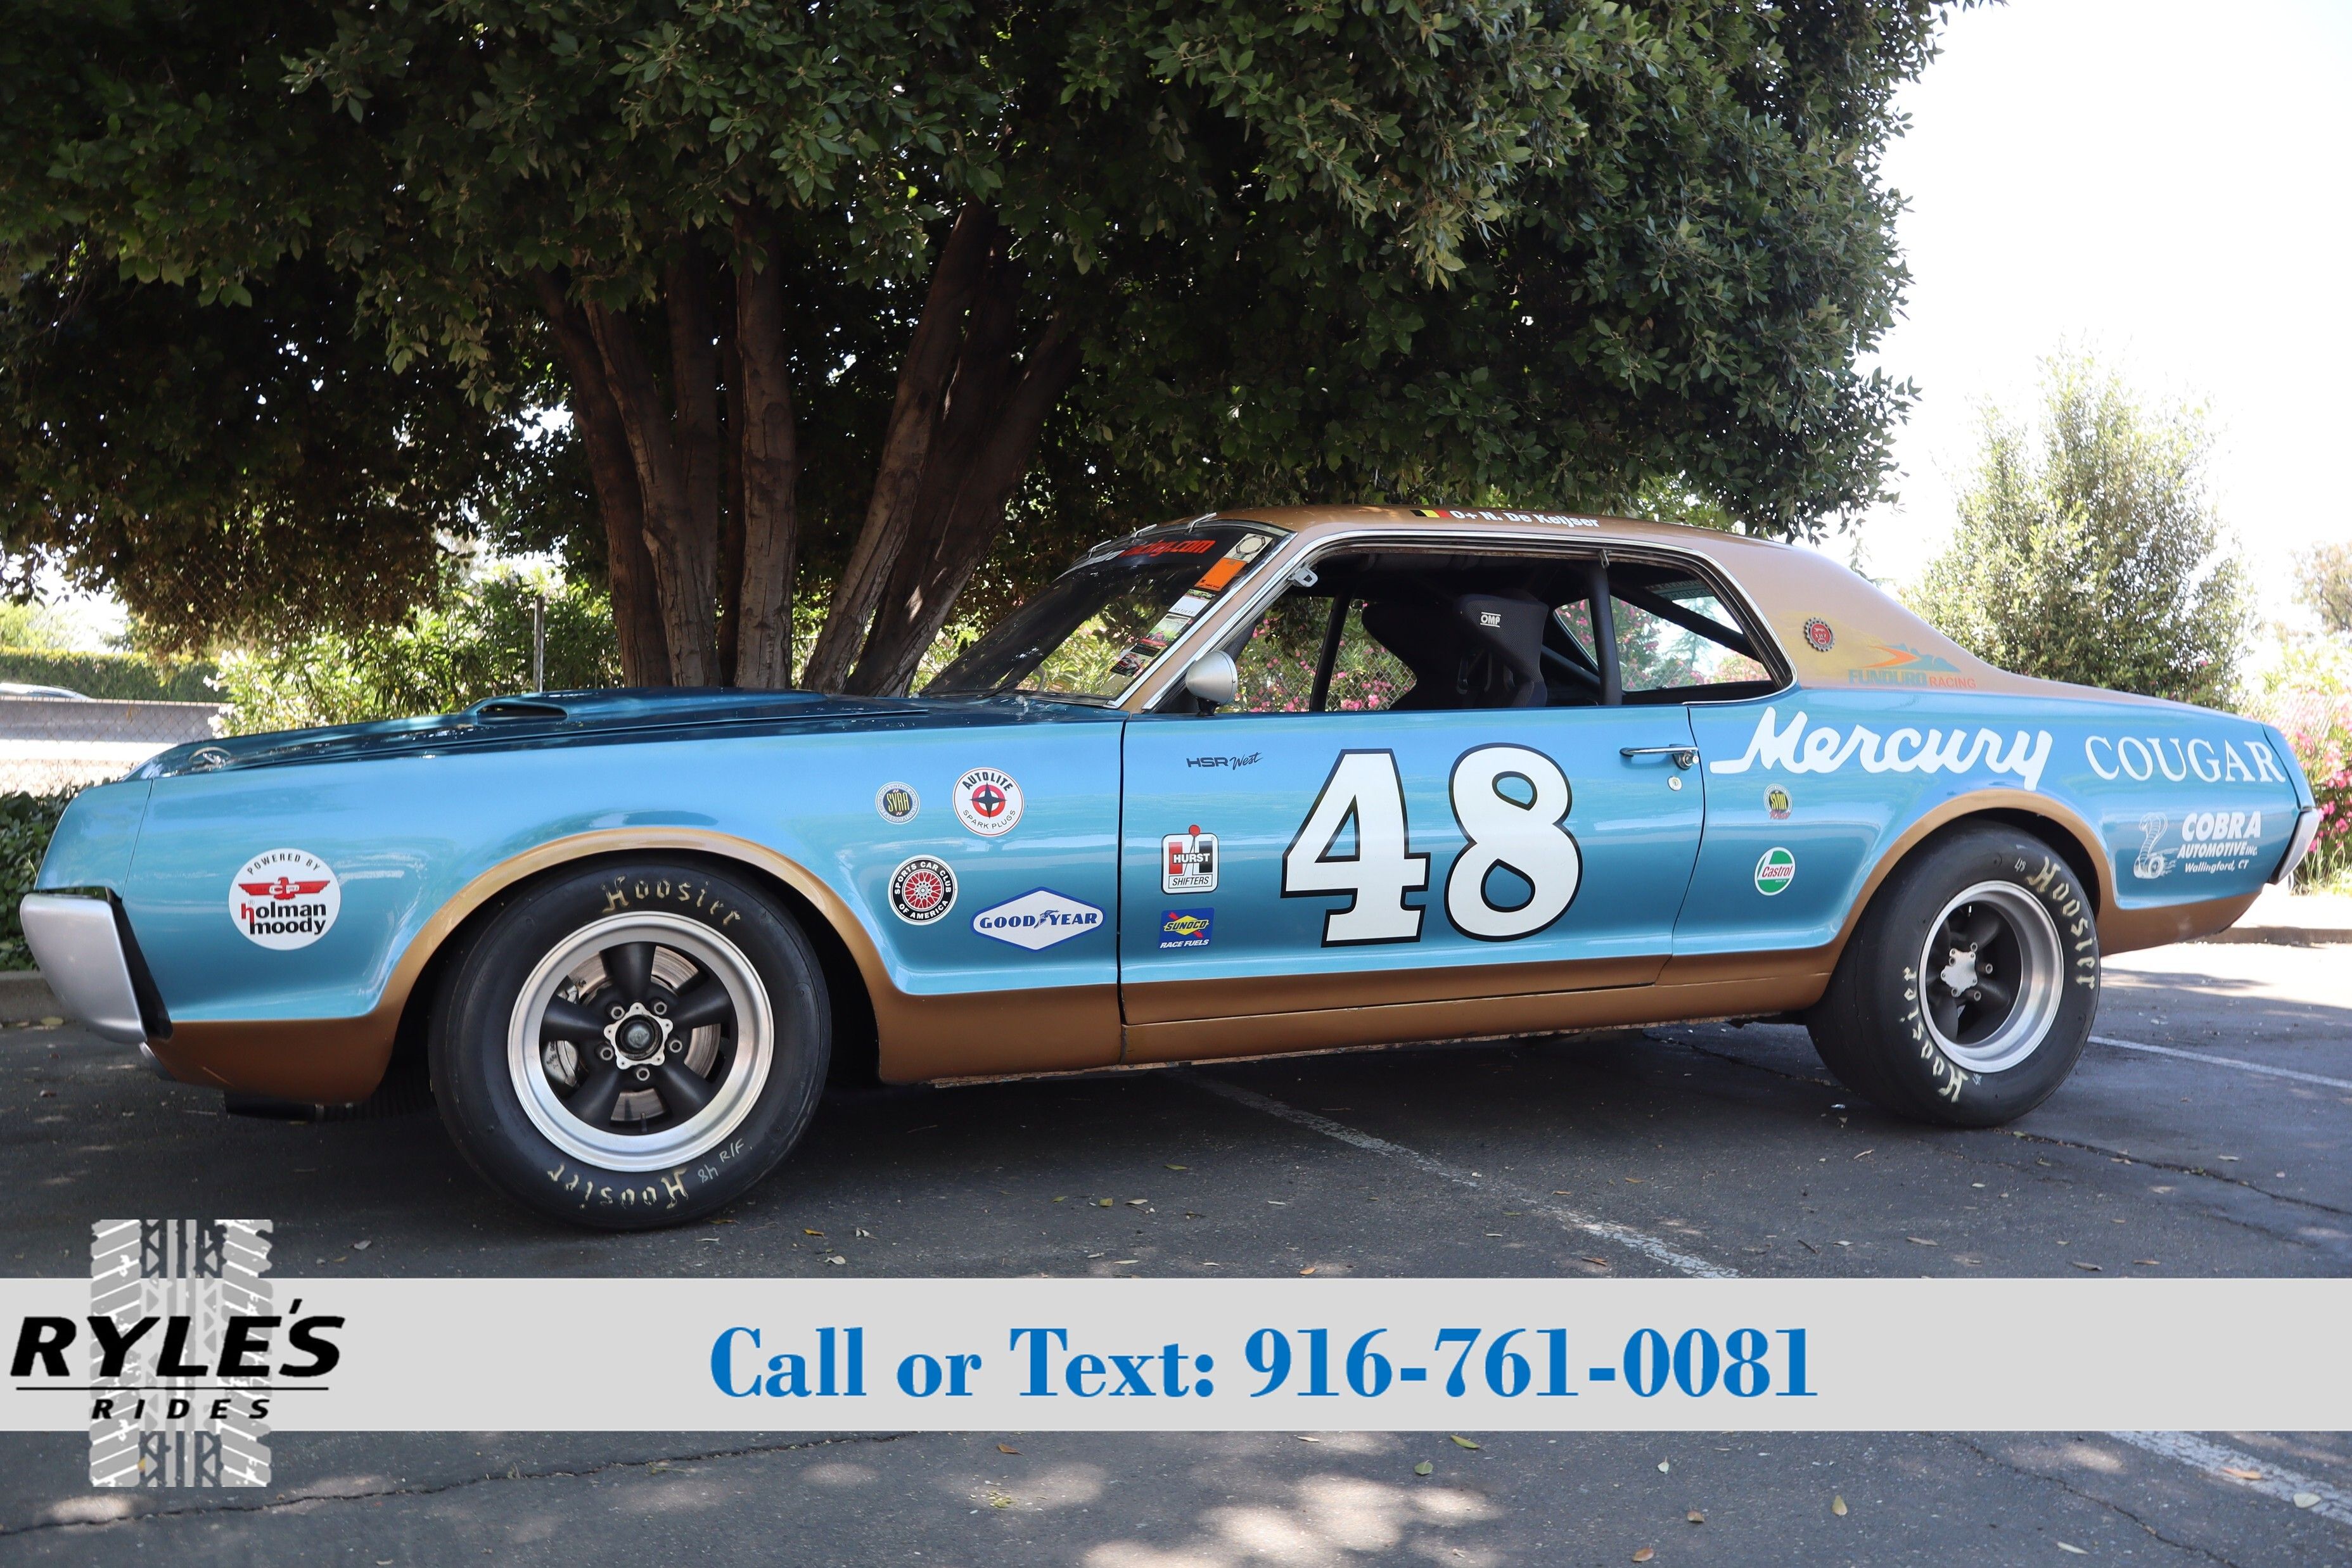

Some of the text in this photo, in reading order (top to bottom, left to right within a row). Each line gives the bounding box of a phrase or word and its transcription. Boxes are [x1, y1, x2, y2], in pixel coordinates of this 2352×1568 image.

[1503, 512, 1532, 523] De
[1481, 614, 1500, 625] OMP
[1848, 668, 1977, 689] FUNDURO RACING
[1711, 706, 2053, 791] Mercury
[1186, 751, 1263, 770] HSR West
[2085, 735, 2286, 783] COUGAR
[962, 771, 1014, 792] AUTOLITE
[886, 792, 910, 812] SVRA
[909, 789, 917, 808] RACING
[963, 810, 1016, 829] SPARK PLUGS
[2182, 810, 2261, 842] COBRA
[1280, 742, 1583, 948] 48
[2176, 841, 2247, 859] AUTOMOTIVE
[247, 853, 320, 876] POWERED BY
[1173, 853, 1210, 864] HURST
[2185, 859, 2249, 874] Wallingford, CT
[894, 861, 952, 895] SPORTS CAR CLUB
[1762, 865, 1794, 877] Castrol
[1172, 876, 1210, 886] SHIFTERS
[602, 875, 741, 926] Hoosier
[898, 900, 949, 919] OF AMERICA
[241, 901, 326, 920] holman
[250, 917, 326, 936] moody
[1165, 920, 1208, 931] SUNOCO
[2026, 856, 2097, 990] Hoosier
[1160, 938, 1210, 948] RACE FUELS
[1899, 966, 1969, 1103] Hoosier
